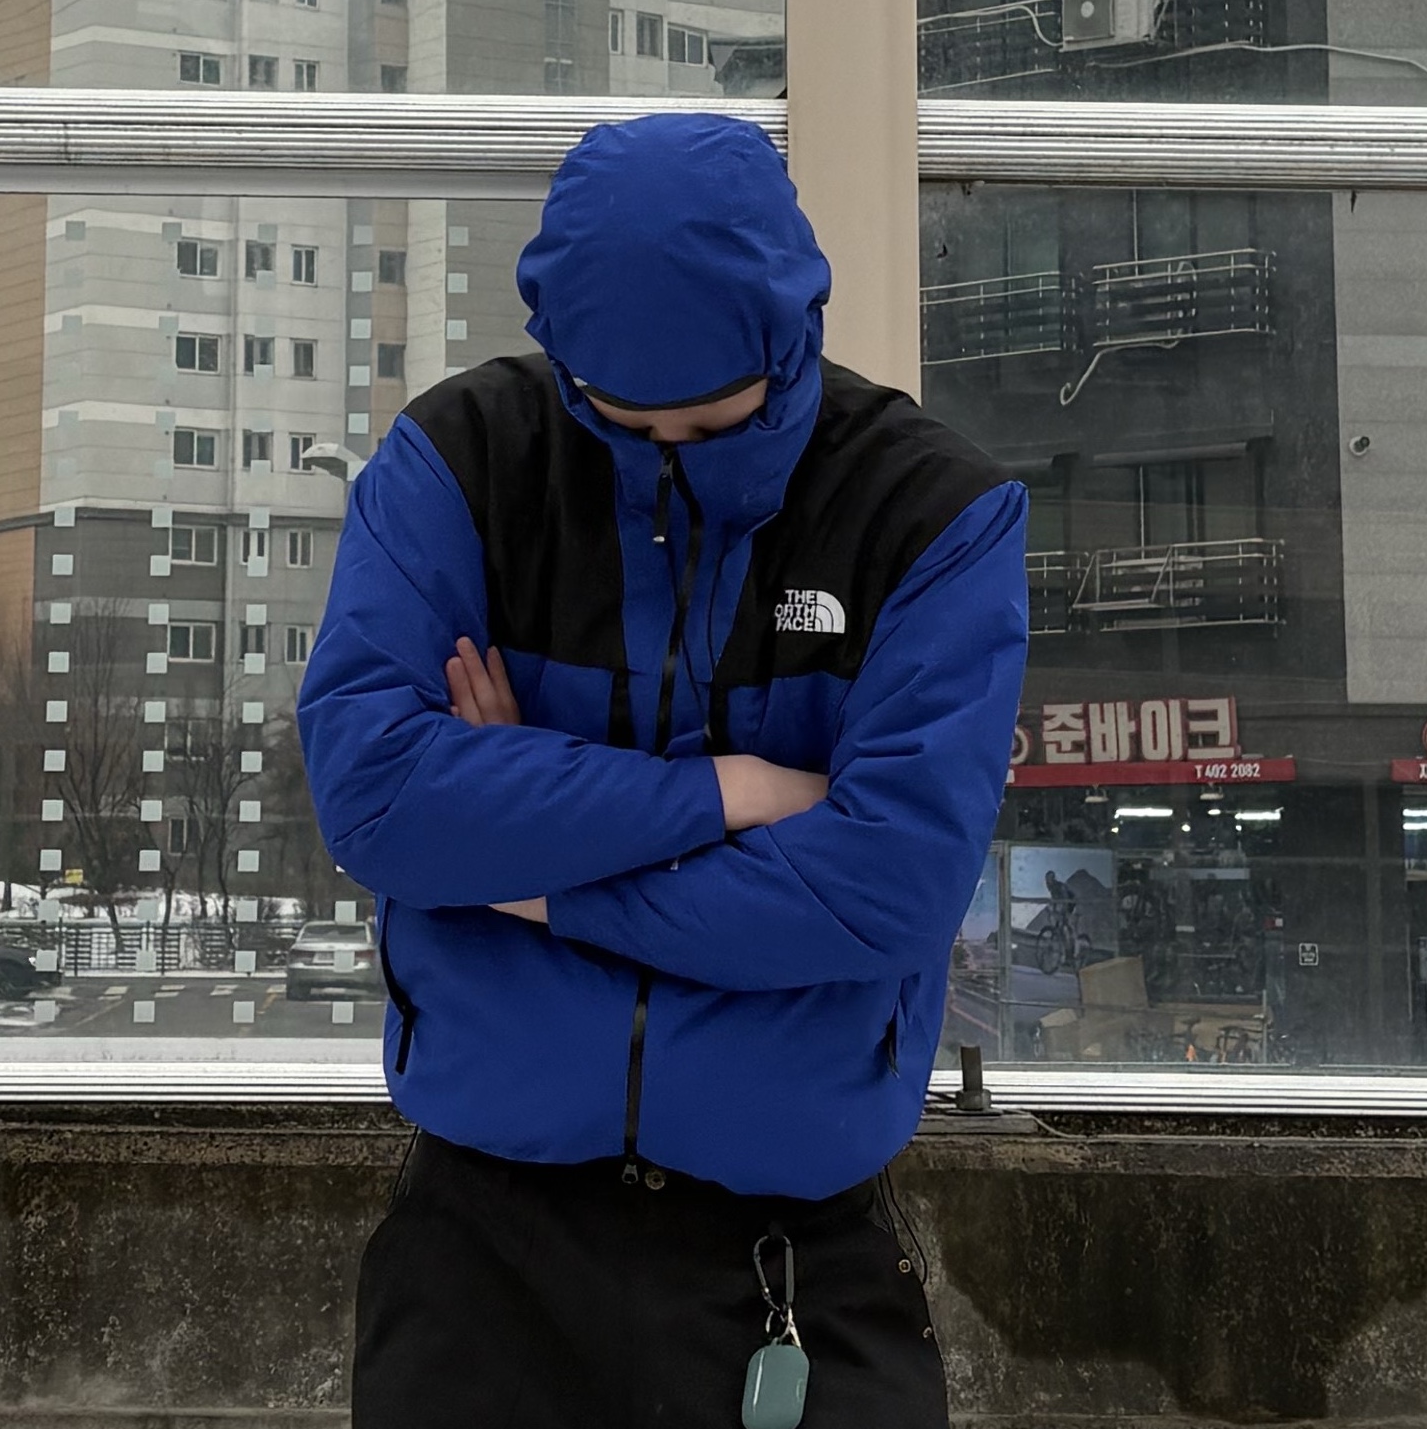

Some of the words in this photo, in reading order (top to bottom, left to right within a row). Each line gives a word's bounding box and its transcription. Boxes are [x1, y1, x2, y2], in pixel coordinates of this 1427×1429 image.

[784, 589, 816, 604] THE
[775, 603, 815, 620] ORTH
[775, 617, 815, 632] FACE
[1041, 697, 1238, 764] 준바이크
